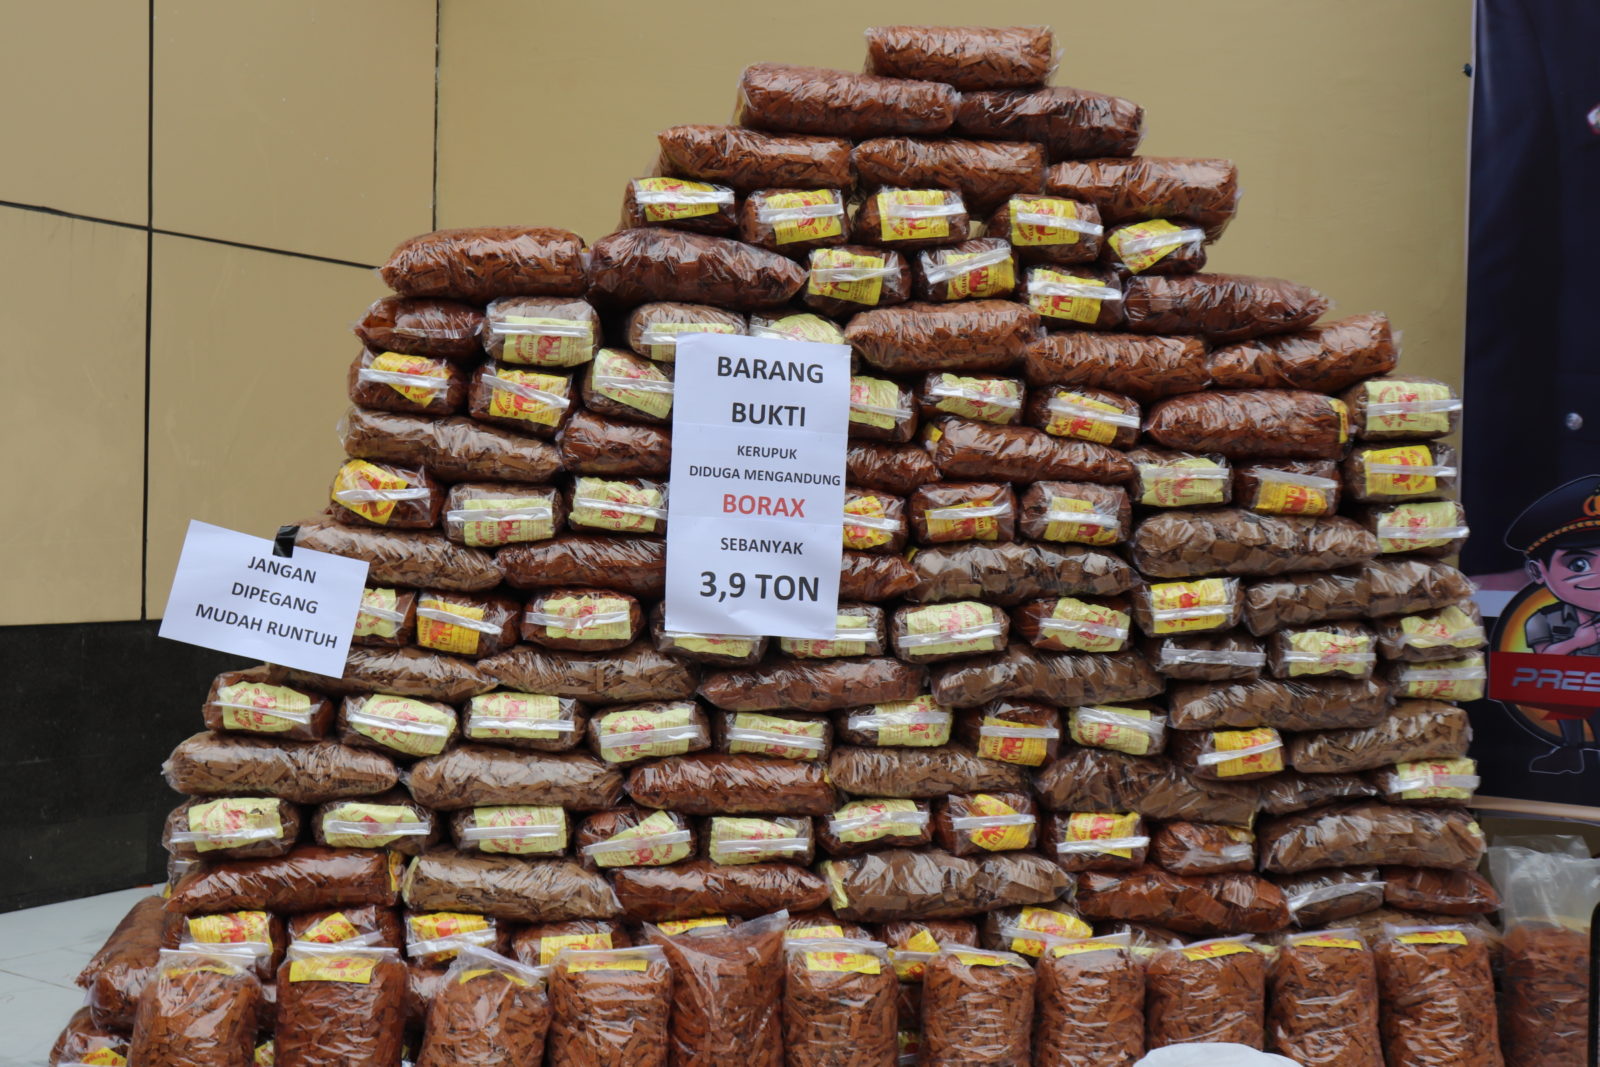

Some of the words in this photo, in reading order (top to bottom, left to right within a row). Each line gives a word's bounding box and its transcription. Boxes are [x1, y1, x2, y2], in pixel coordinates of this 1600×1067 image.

[717, 355, 824, 384] BARANG
[731, 401, 806, 428] BUKTI
[737, 445, 798, 460] KERUPUK
[689, 465, 741, 480] DIDUGA
[744, 468, 841, 487] MENGANDUNG
[723, 493, 806, 518] BORAX
[720, 537, 804, 556] SEBANYAK
[247, 556, 317, 584] JANGAN
[231, 581, 319, 615] DIPEGANG
[699, 570, 746, 603] 3,9
[754, 573, 820, 602] TON
[195, 603, 263, 632] MUDAH
[266, 620, 338, 649] RUNTUH
